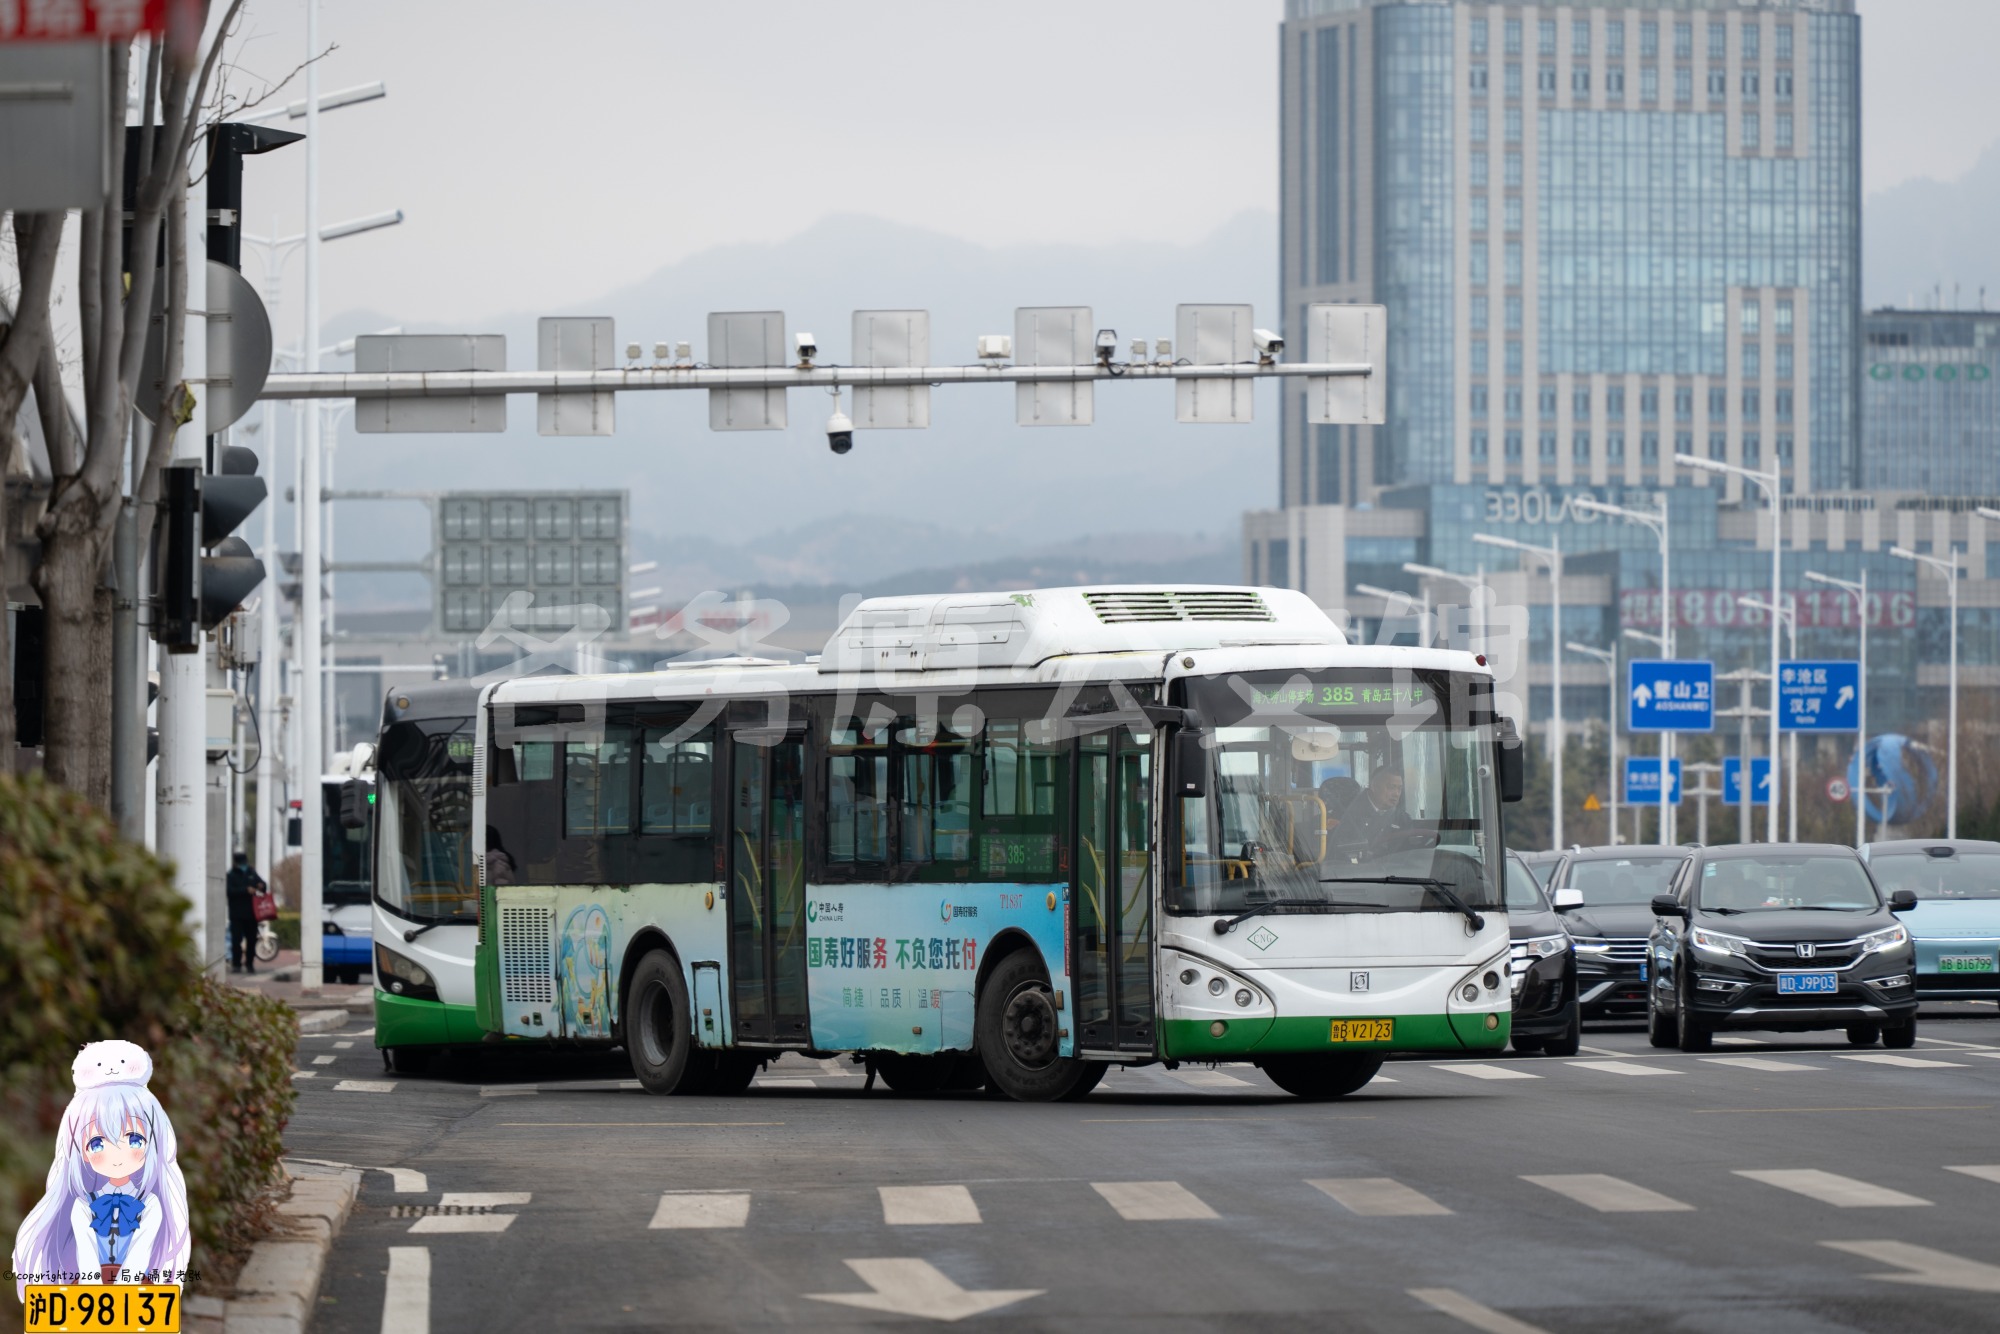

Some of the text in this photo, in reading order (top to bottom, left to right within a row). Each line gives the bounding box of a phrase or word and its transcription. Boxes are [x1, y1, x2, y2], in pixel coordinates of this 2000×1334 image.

[1869, 362, 1990, 383] GOOD
[1322, 686, 1354, 702] 385
[1362, 688, 1423, 704] 青岛五十八中
[1007, 844, 1025, 865] 385
[818, 902, 844, 914] 中国人寿
[1000, 894, 1023, 909] T1837
[952, 906, 978, 918] 国寿好服务
[1253, 934, 1272, 944] CNG
[808, 937, 977, 970] 国寿好服务 不负您托付
[880, 988, 902, 1009] 品质
[918, 988, 940, 1009] 温暖
